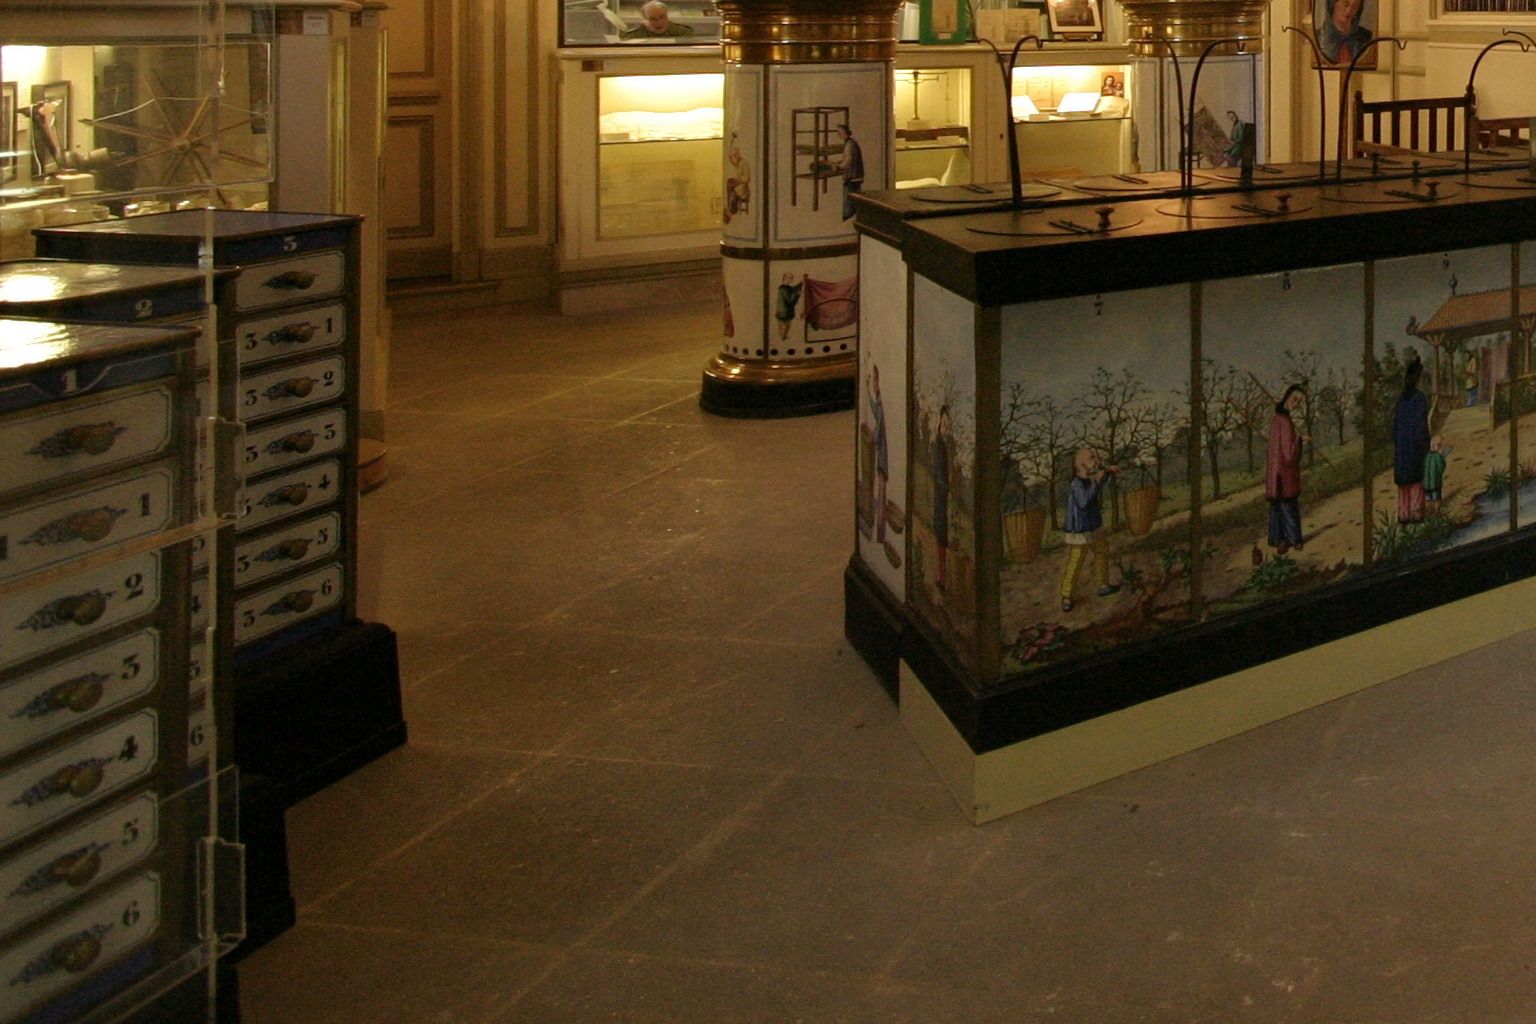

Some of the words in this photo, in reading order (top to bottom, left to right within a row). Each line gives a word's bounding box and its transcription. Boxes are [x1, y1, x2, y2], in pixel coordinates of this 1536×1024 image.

[135, 299, 154, 318] 2
[1094, 301, 1104, 316] 7
[325, 317, 333, 333] 1
[60, 368, 78, 396] 1
[323, 370, 334, 387] 2
[317, 473, 331, 490] 4
[139, 492, 152, 517] 1
[124, 572, 145, 601] 2
[320, 578, 333, 596] 6
[190, 725, 204, 746] 6
[118, 734, 139, 762] 4
[121, 818, 139, 846] 5
[122, 900, 141, 927] 6
